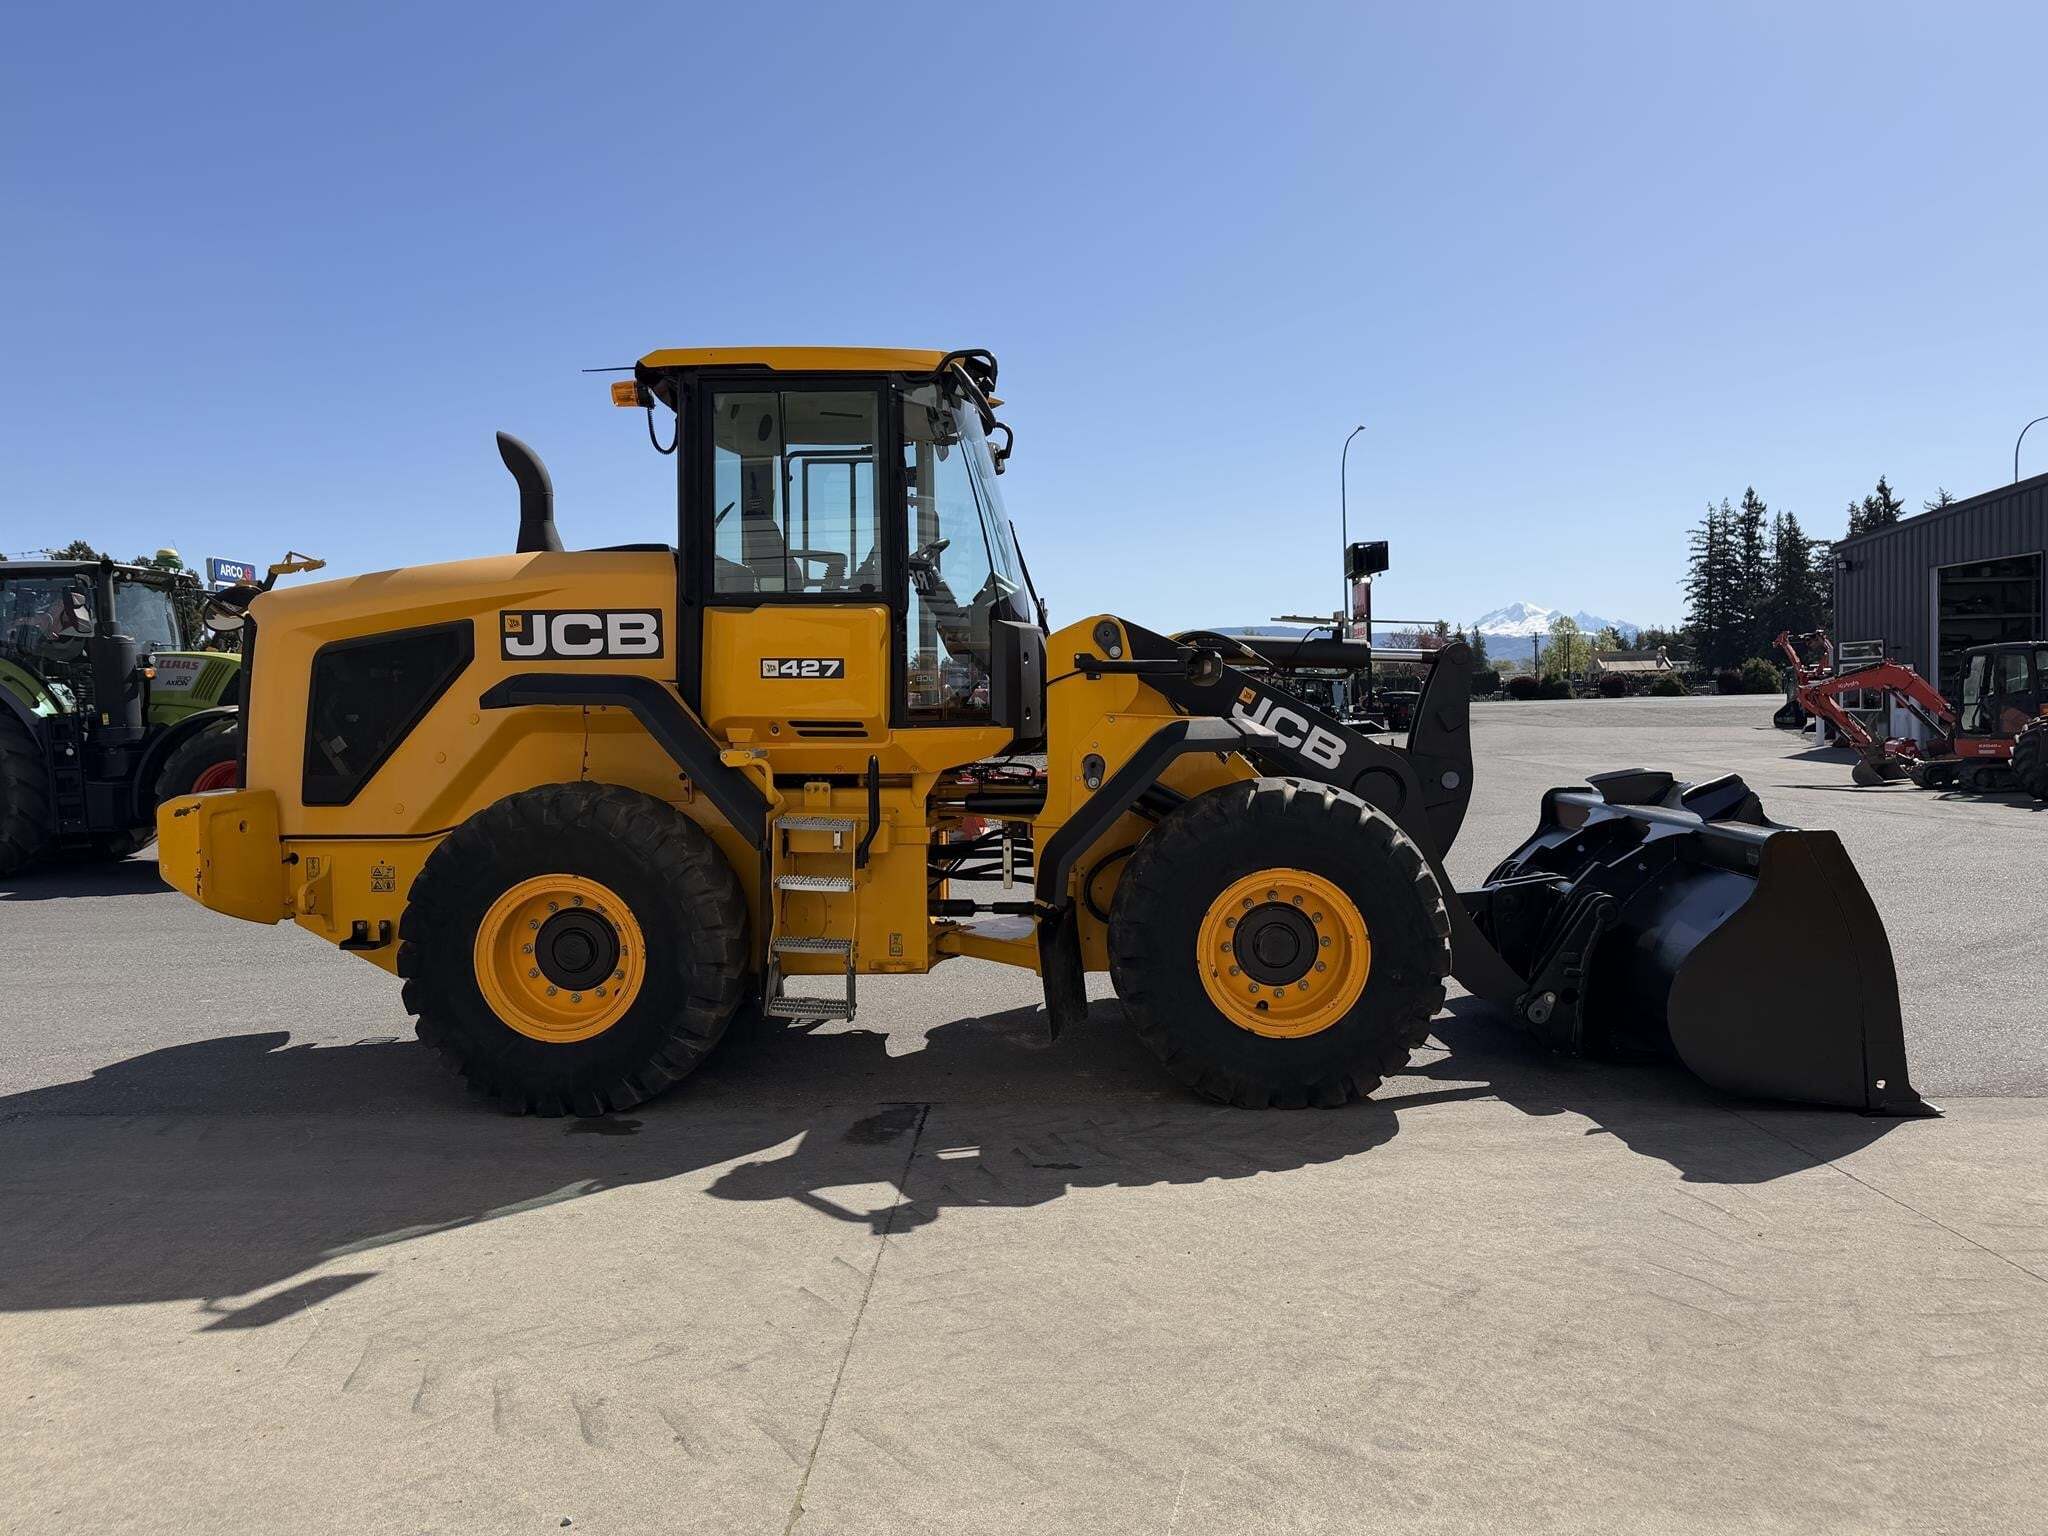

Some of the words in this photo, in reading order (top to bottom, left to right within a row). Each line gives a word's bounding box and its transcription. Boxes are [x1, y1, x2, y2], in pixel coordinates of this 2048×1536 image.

[220, 563, 243, 579] ARCO
[505, 613, 660, 656] JCB
[160, 660, 199, 670] CLAAS
[780, 660, 840, 677] 427
[1231, 696, 1347, 770] JCB
